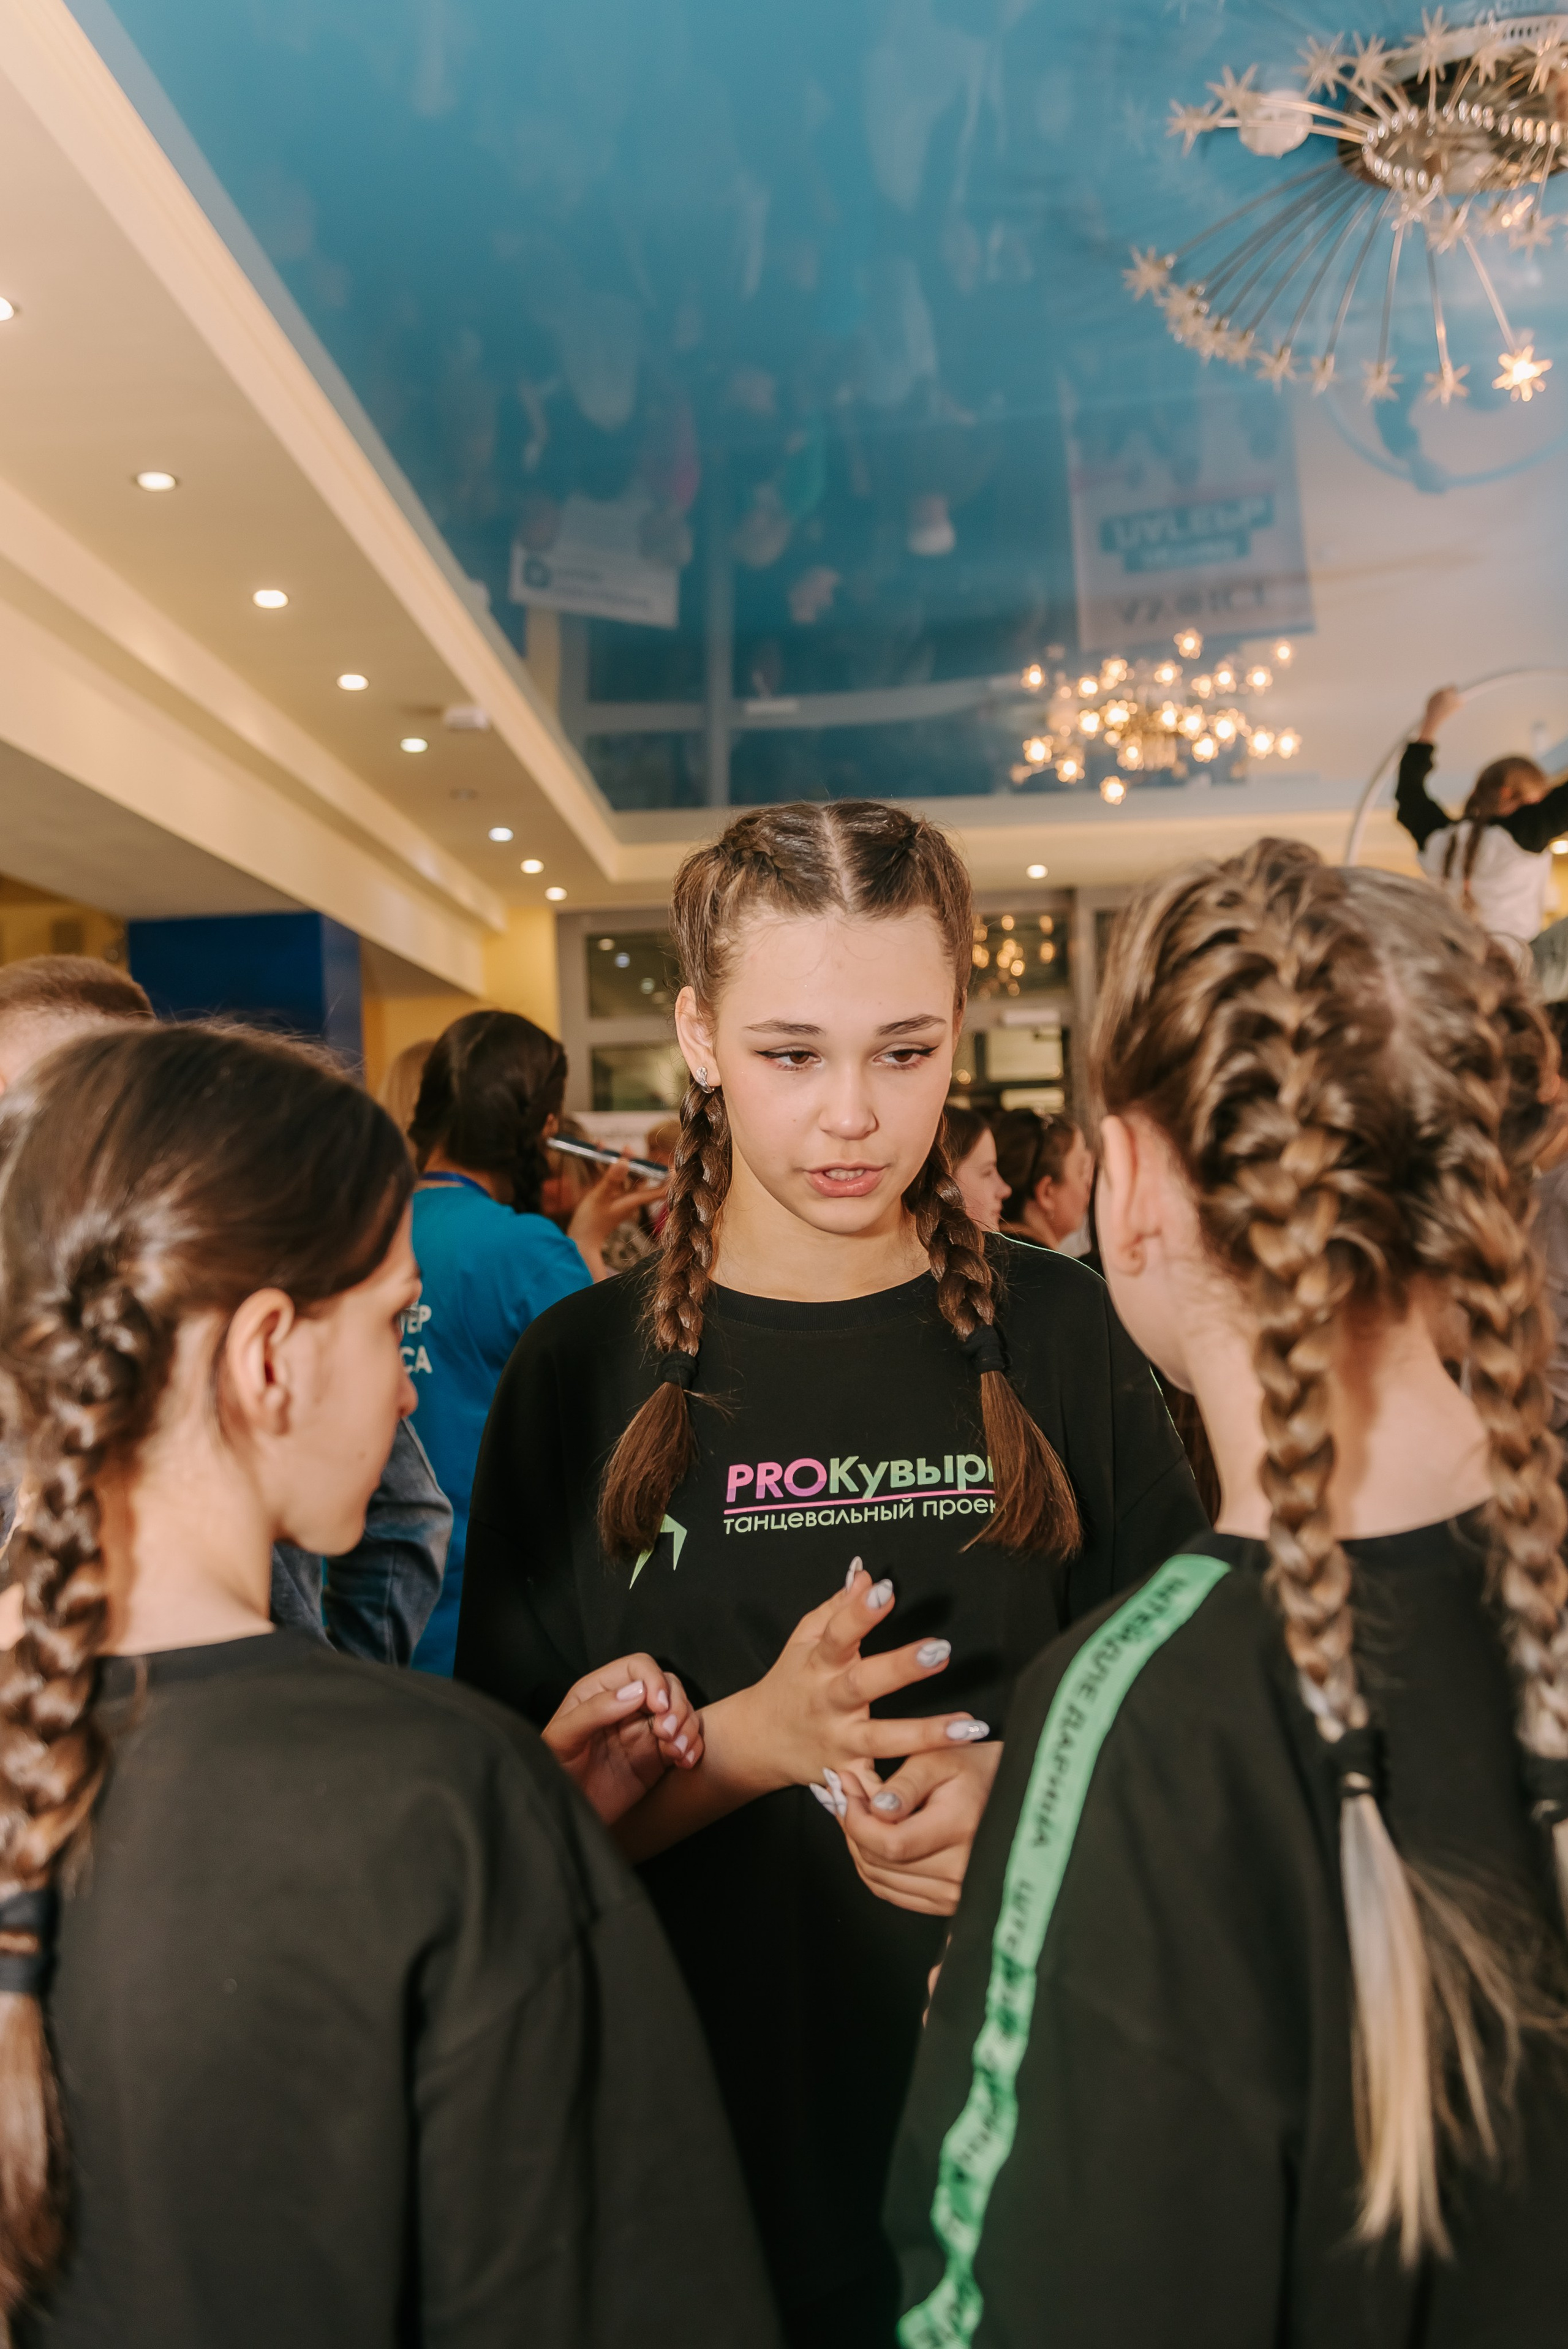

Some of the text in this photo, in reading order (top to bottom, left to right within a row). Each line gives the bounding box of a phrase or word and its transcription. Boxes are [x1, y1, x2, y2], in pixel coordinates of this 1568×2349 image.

[726, 1454, 993, 1503] PROКувыр
[723, 1498, 995, 1534] танцевальный проек
